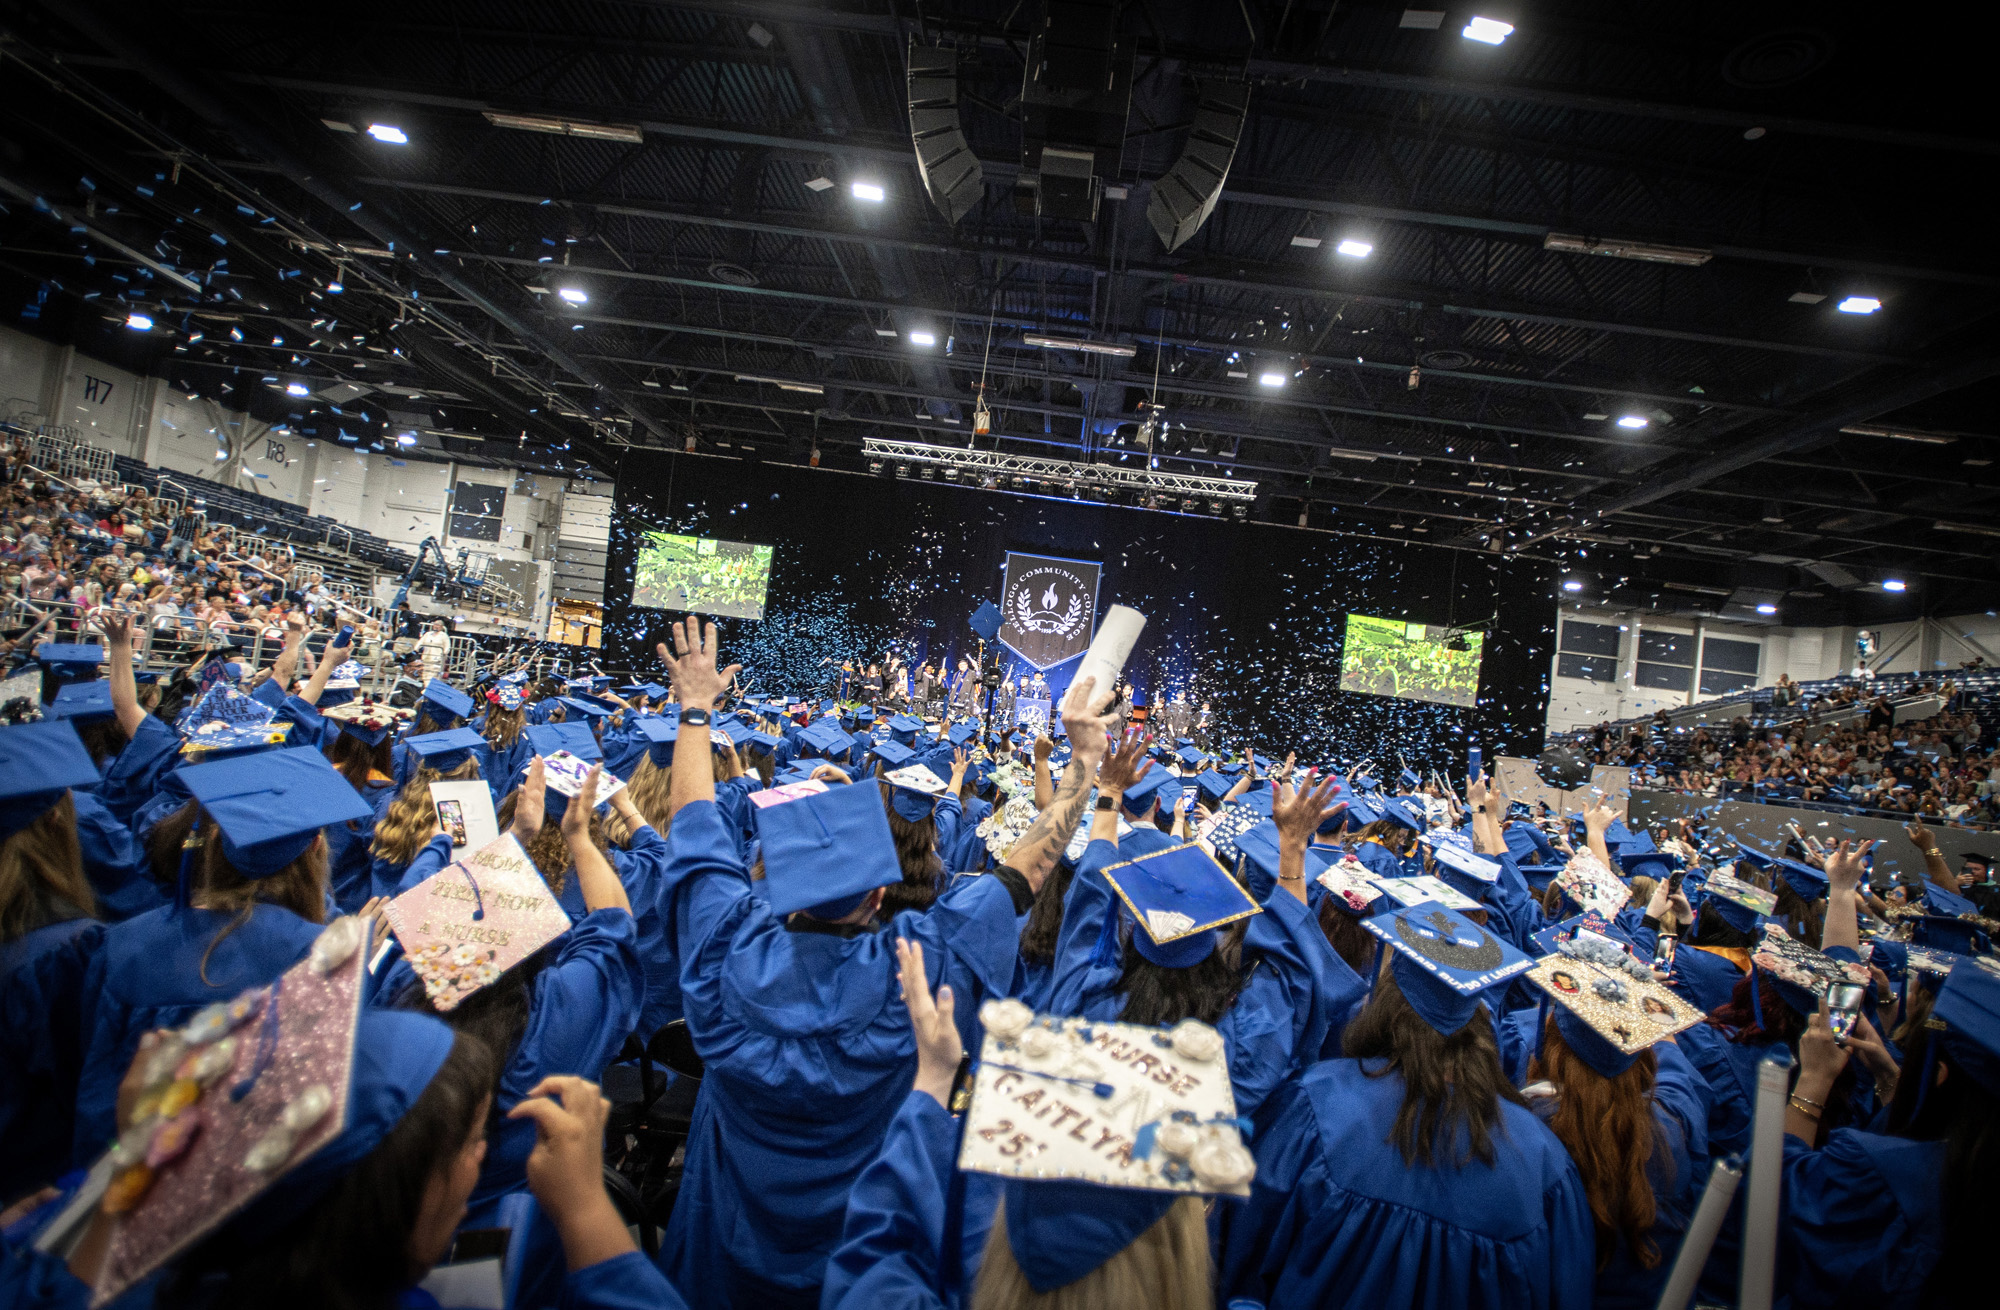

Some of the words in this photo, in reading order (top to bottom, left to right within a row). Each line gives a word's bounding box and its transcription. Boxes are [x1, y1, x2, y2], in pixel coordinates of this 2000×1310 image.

[1006, 583, 1025, 635] KELLOGG
[1019, 567, 1086, 590] COMMUNITY
[1066, 593, 1092, 641] COLLEGE
[471, 850, 524, 873] MOM
[431, 880, 490, 903] FIRST
[493, 891, 546, 913] NOW
[416, 920, 431, 935] A
[441, 922, 513, 947] NURSE
[1419, 928, 1434, 938] RN
[1457, 937, 1480, 948] 2025
[1360, 920, 1394, 940] STAY
[1393, 941, 1438, 971] AFRAID
[1438, 971, 1467, 990] BUT
[1465, 980, 1482, 991] DO
[1479, 975, 1492, 984] IT
[1489, 959, 1534, 980] LAUGHING
[1092, 1030, 1202, 1098] NURSE
[992, 1071, 1136, 1169] CAITLYN
